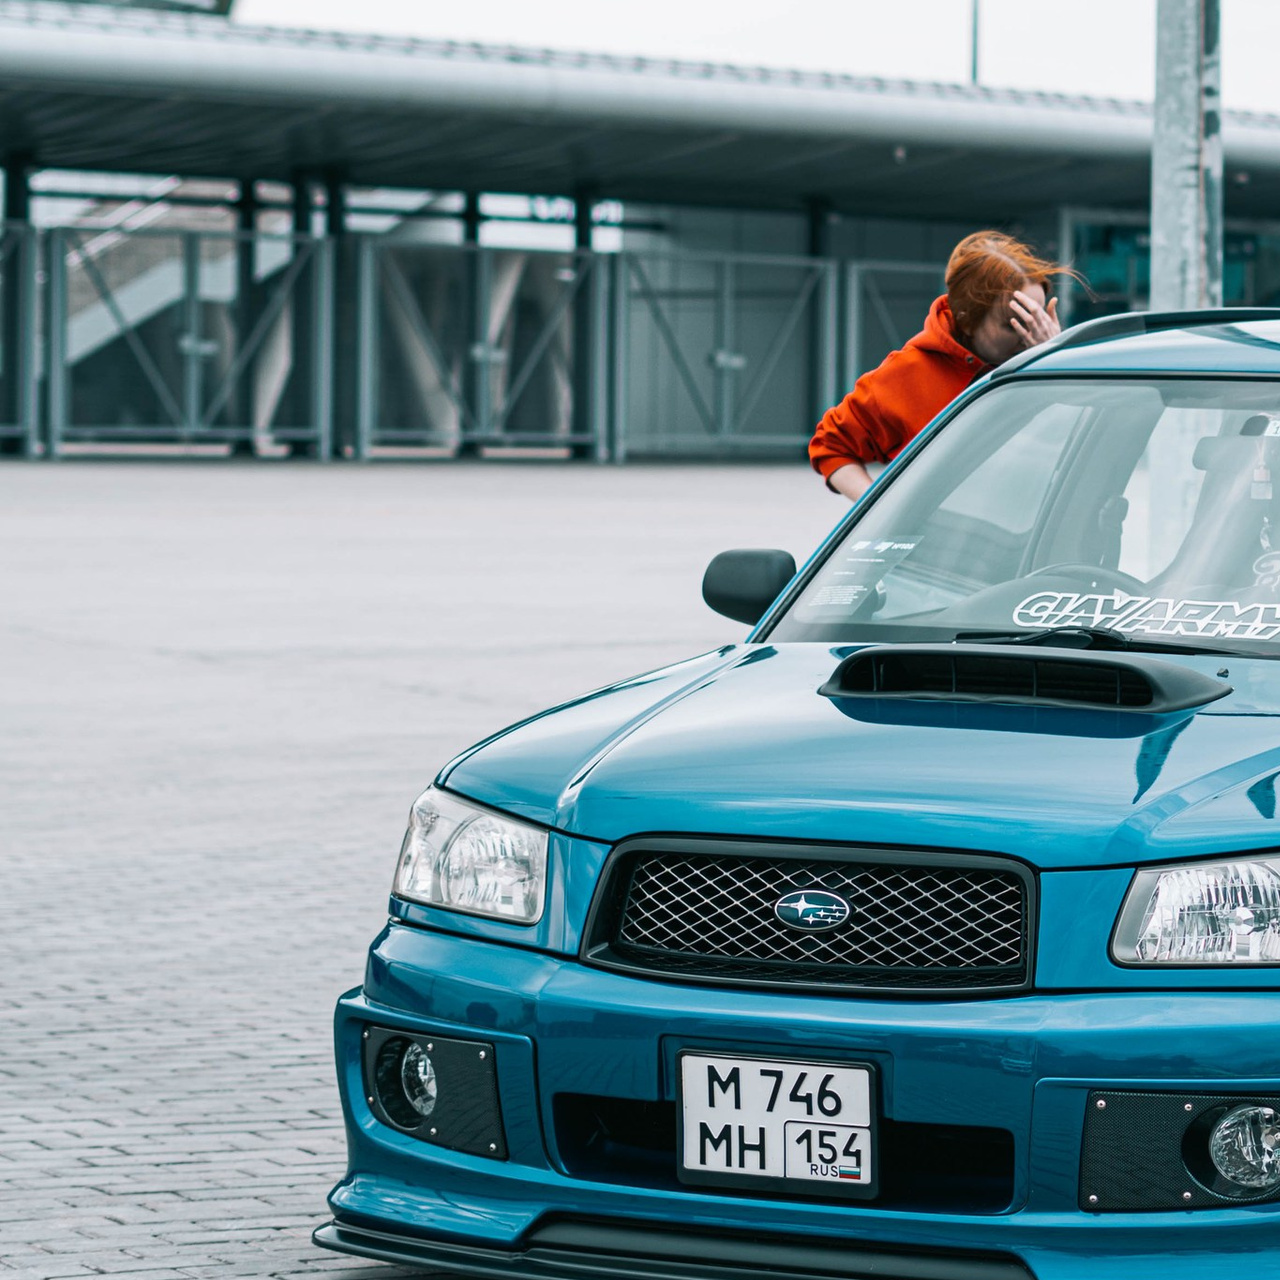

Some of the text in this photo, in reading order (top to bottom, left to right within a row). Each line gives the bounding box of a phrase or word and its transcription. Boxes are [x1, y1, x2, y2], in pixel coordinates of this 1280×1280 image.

[706, 1064, 843, 1117] M 746
[699, 1121, 863, 1170] MH 154
[809, 1163, 840, 1178] RUS
